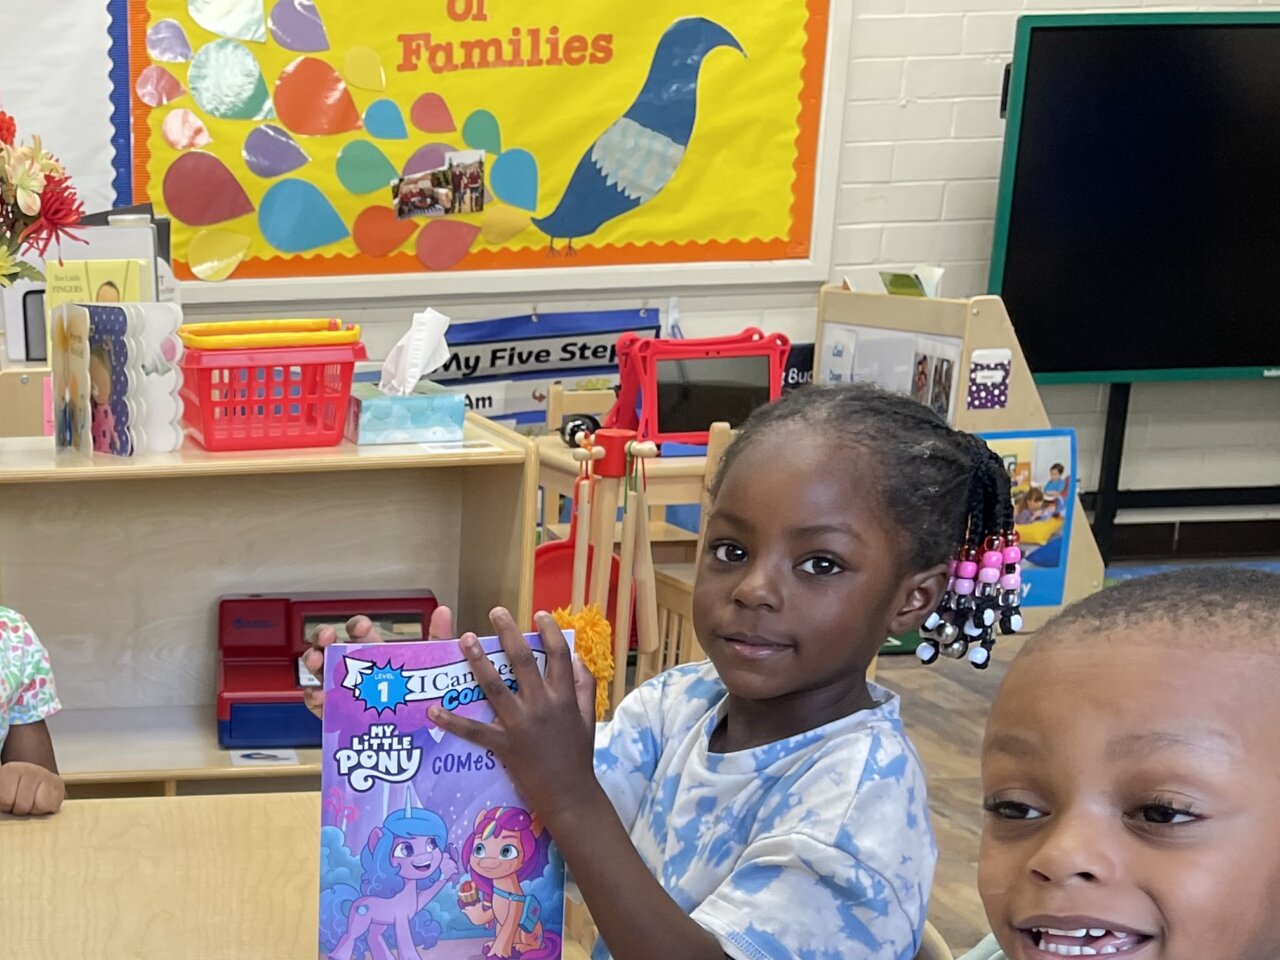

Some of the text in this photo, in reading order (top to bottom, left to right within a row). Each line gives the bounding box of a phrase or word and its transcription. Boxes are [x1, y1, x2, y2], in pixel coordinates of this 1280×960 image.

[397, 26, 614, 74] Families
[433, 352, 480, 377] My
[490, 347, 551, 367] Five
[374, 673, 394, 681] LEVEL
[378, 670, 475, 703] 1 I Can
[370, 725, 395, 737] MY
[335, 748, 422, 791] PONY
